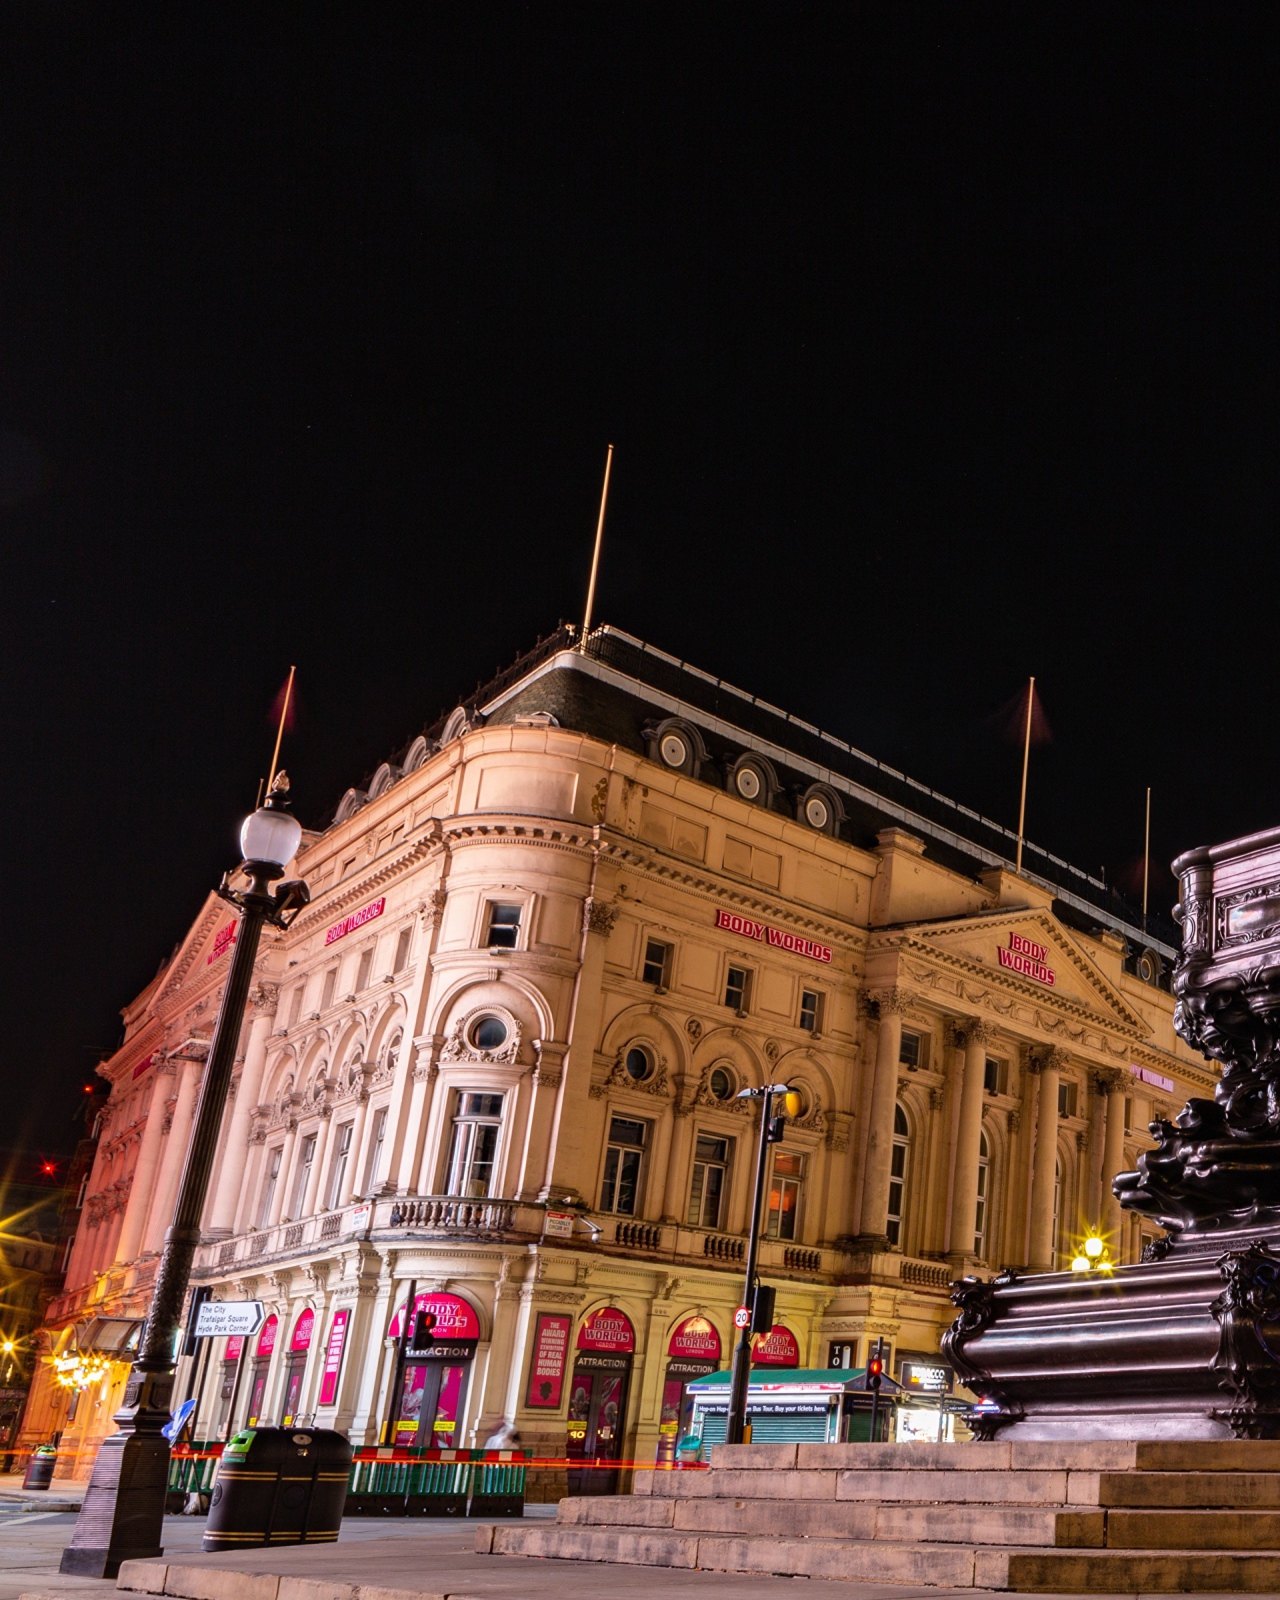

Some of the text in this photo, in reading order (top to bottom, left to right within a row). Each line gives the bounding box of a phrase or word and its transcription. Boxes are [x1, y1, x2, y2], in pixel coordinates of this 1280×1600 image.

[717, 911, 833, 963] BODY WORLDS
[1010, 933, 1049, 965] BODY
[998, 948, 1056, 986] WORLDS
[214, 1306, 226, 1314] City
[200, 1315, 248, 1324] Trafalgar Square
[736, 1313, 747, 1323] 20
[198, 1325, 213, 1333] Hyde
[594, 1319, 624, 1331] BODY
[542, 1329, 566, 1338] AWARD
[584, 1329, 630, 1342] WORLDS
[676, 1337, 716, 1350] WORLDS
[757, 1345, 795, 1356] WORLDS
[538, 1359, 562, 1368] HUMAN
[577, 1357, 626, 1368] ATTRACTION
[537, 1367, 560, 1376] BODIES
[669, 1363, 713, 1373] ATTRACTION
[699, 1405, 716, 1413] Hop-on
